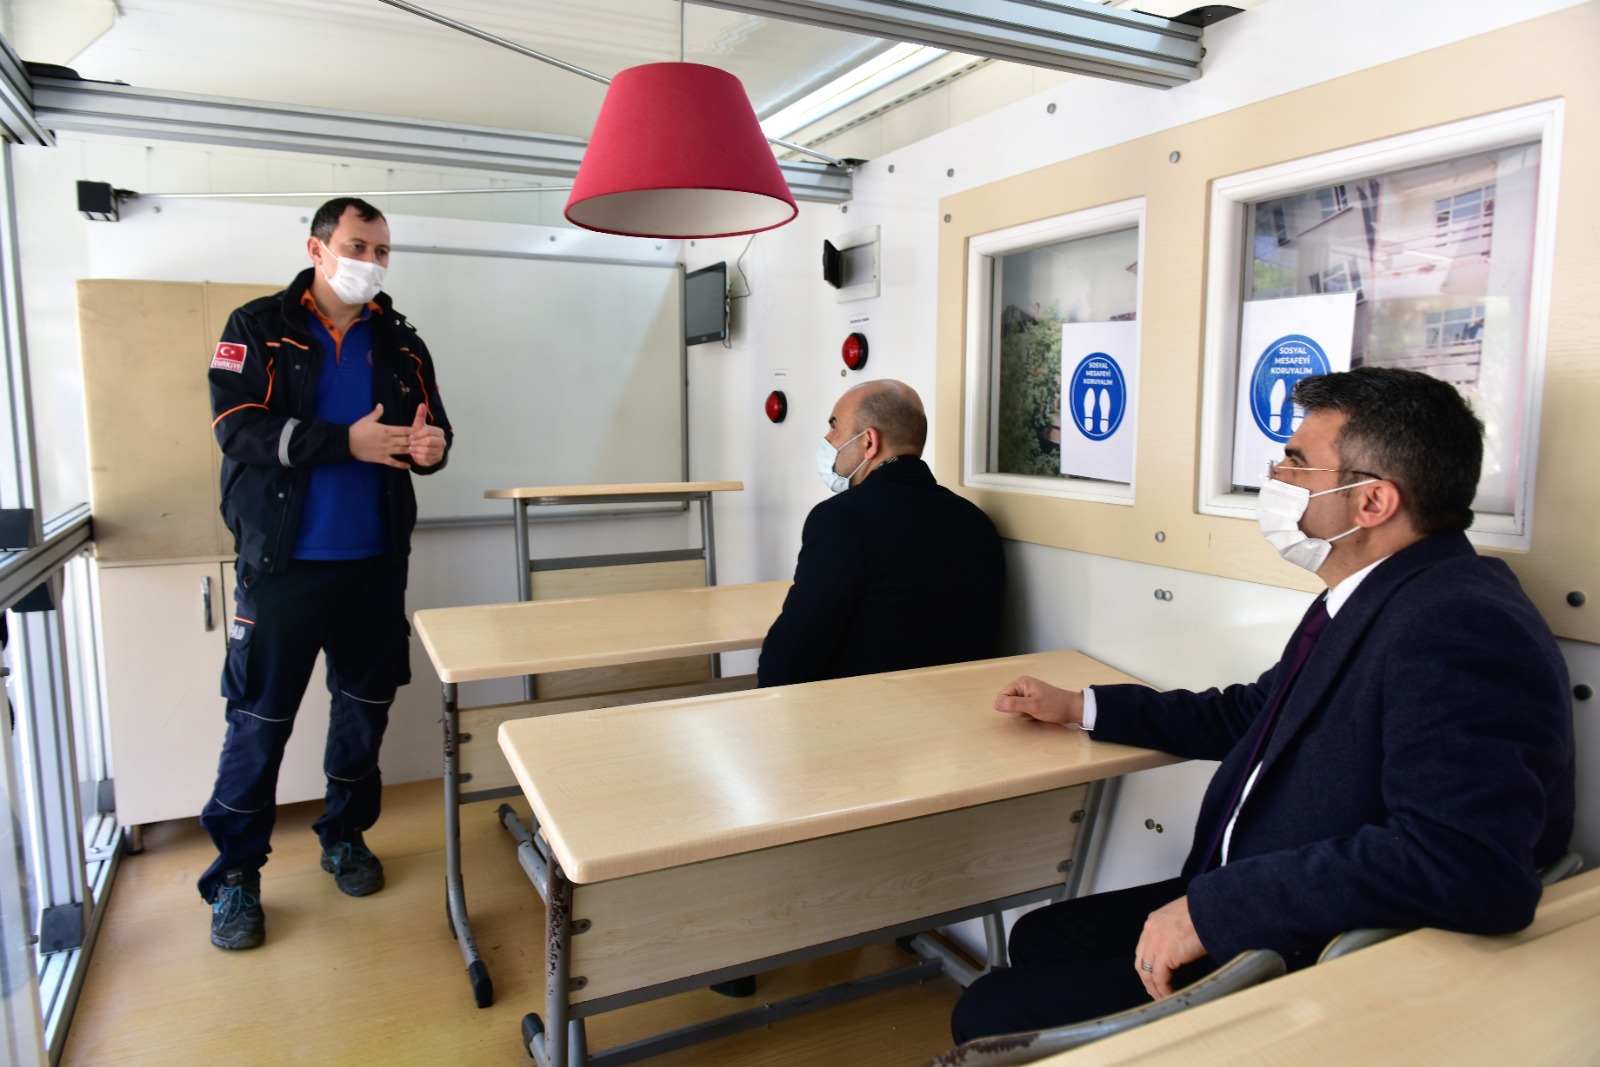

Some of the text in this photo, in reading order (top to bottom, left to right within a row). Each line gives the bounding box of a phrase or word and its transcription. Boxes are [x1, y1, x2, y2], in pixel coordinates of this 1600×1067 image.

[1274, 355, 1311, 364] MESAFEYİ
[1085, 369, 1111, 377] MESAFEYİ
[1270, 367, 1313, 375] KORUYALIM
[1083, 378, 1113, 386] KORUYALIM
